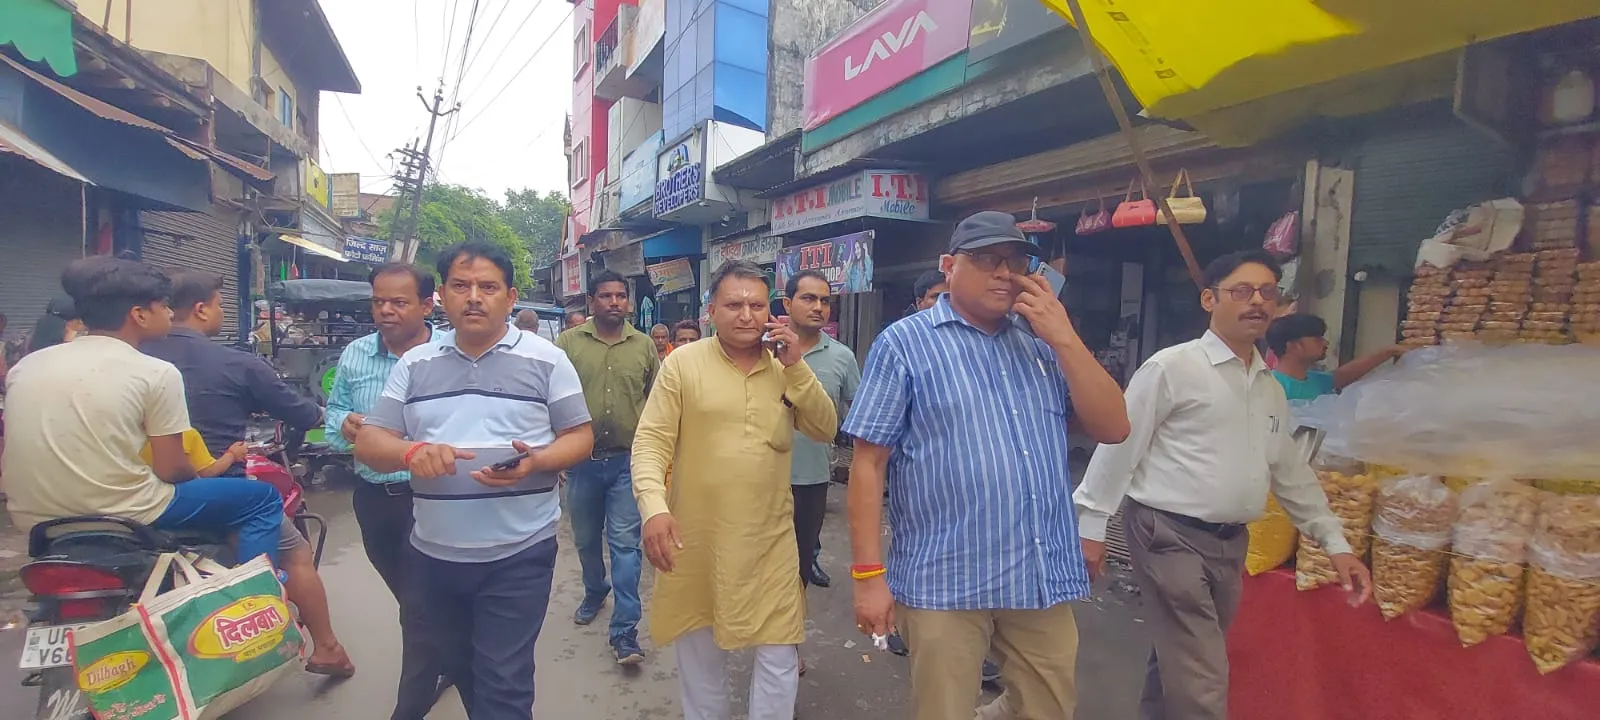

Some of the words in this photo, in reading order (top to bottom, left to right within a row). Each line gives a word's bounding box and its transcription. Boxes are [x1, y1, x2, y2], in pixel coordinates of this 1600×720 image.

[844, 10, 938, 81] LAVA
[655, 163, 701, 200] BROTHERS
[654, 183, 700, 214] DEVELOPERS
[881, 199, 916, 214] Mobile
[800, 242, 832, 271] ITI
[86, 658, 138, 686] Dilbagh
